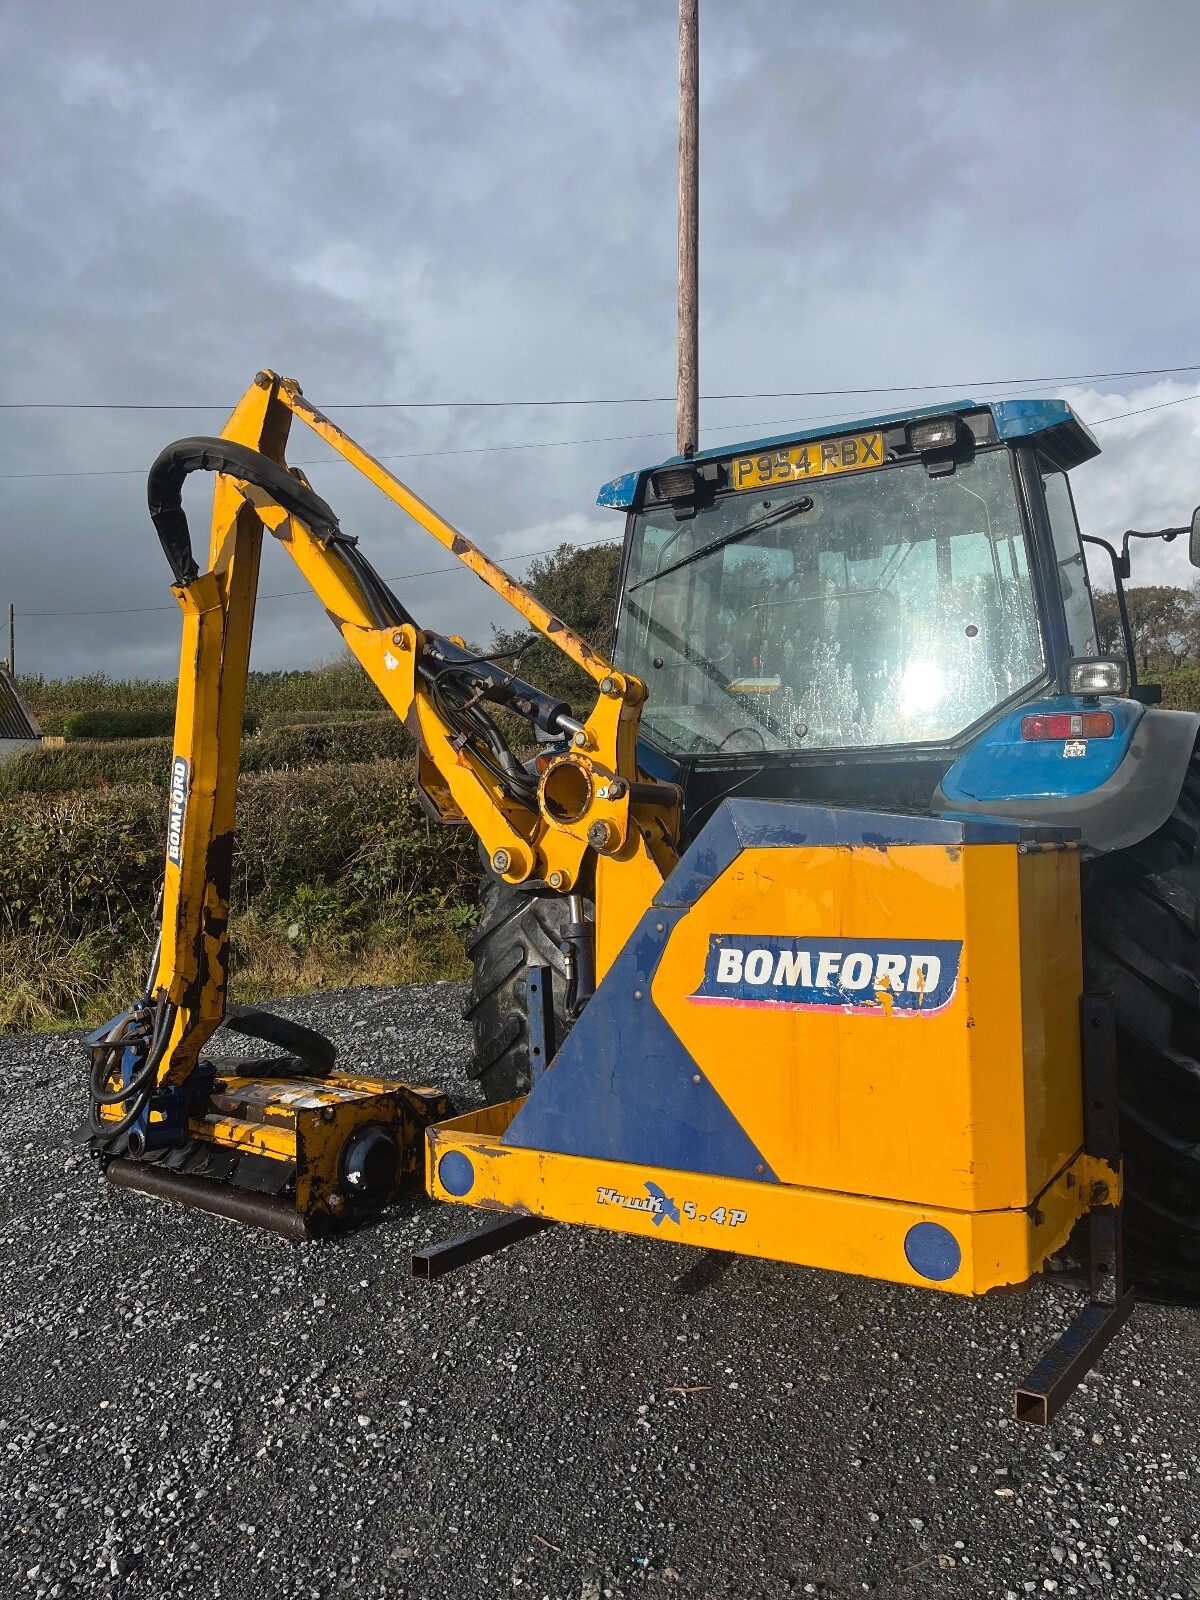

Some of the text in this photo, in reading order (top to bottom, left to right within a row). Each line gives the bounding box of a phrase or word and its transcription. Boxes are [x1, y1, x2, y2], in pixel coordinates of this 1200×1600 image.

[739, 434, 880, 485] P954 RBX
[169, 762, 186, 860] BOMFORD
[716, 948, 941, 993] BOMFORD
[683, 1201, 747, 1227] 5.4P
